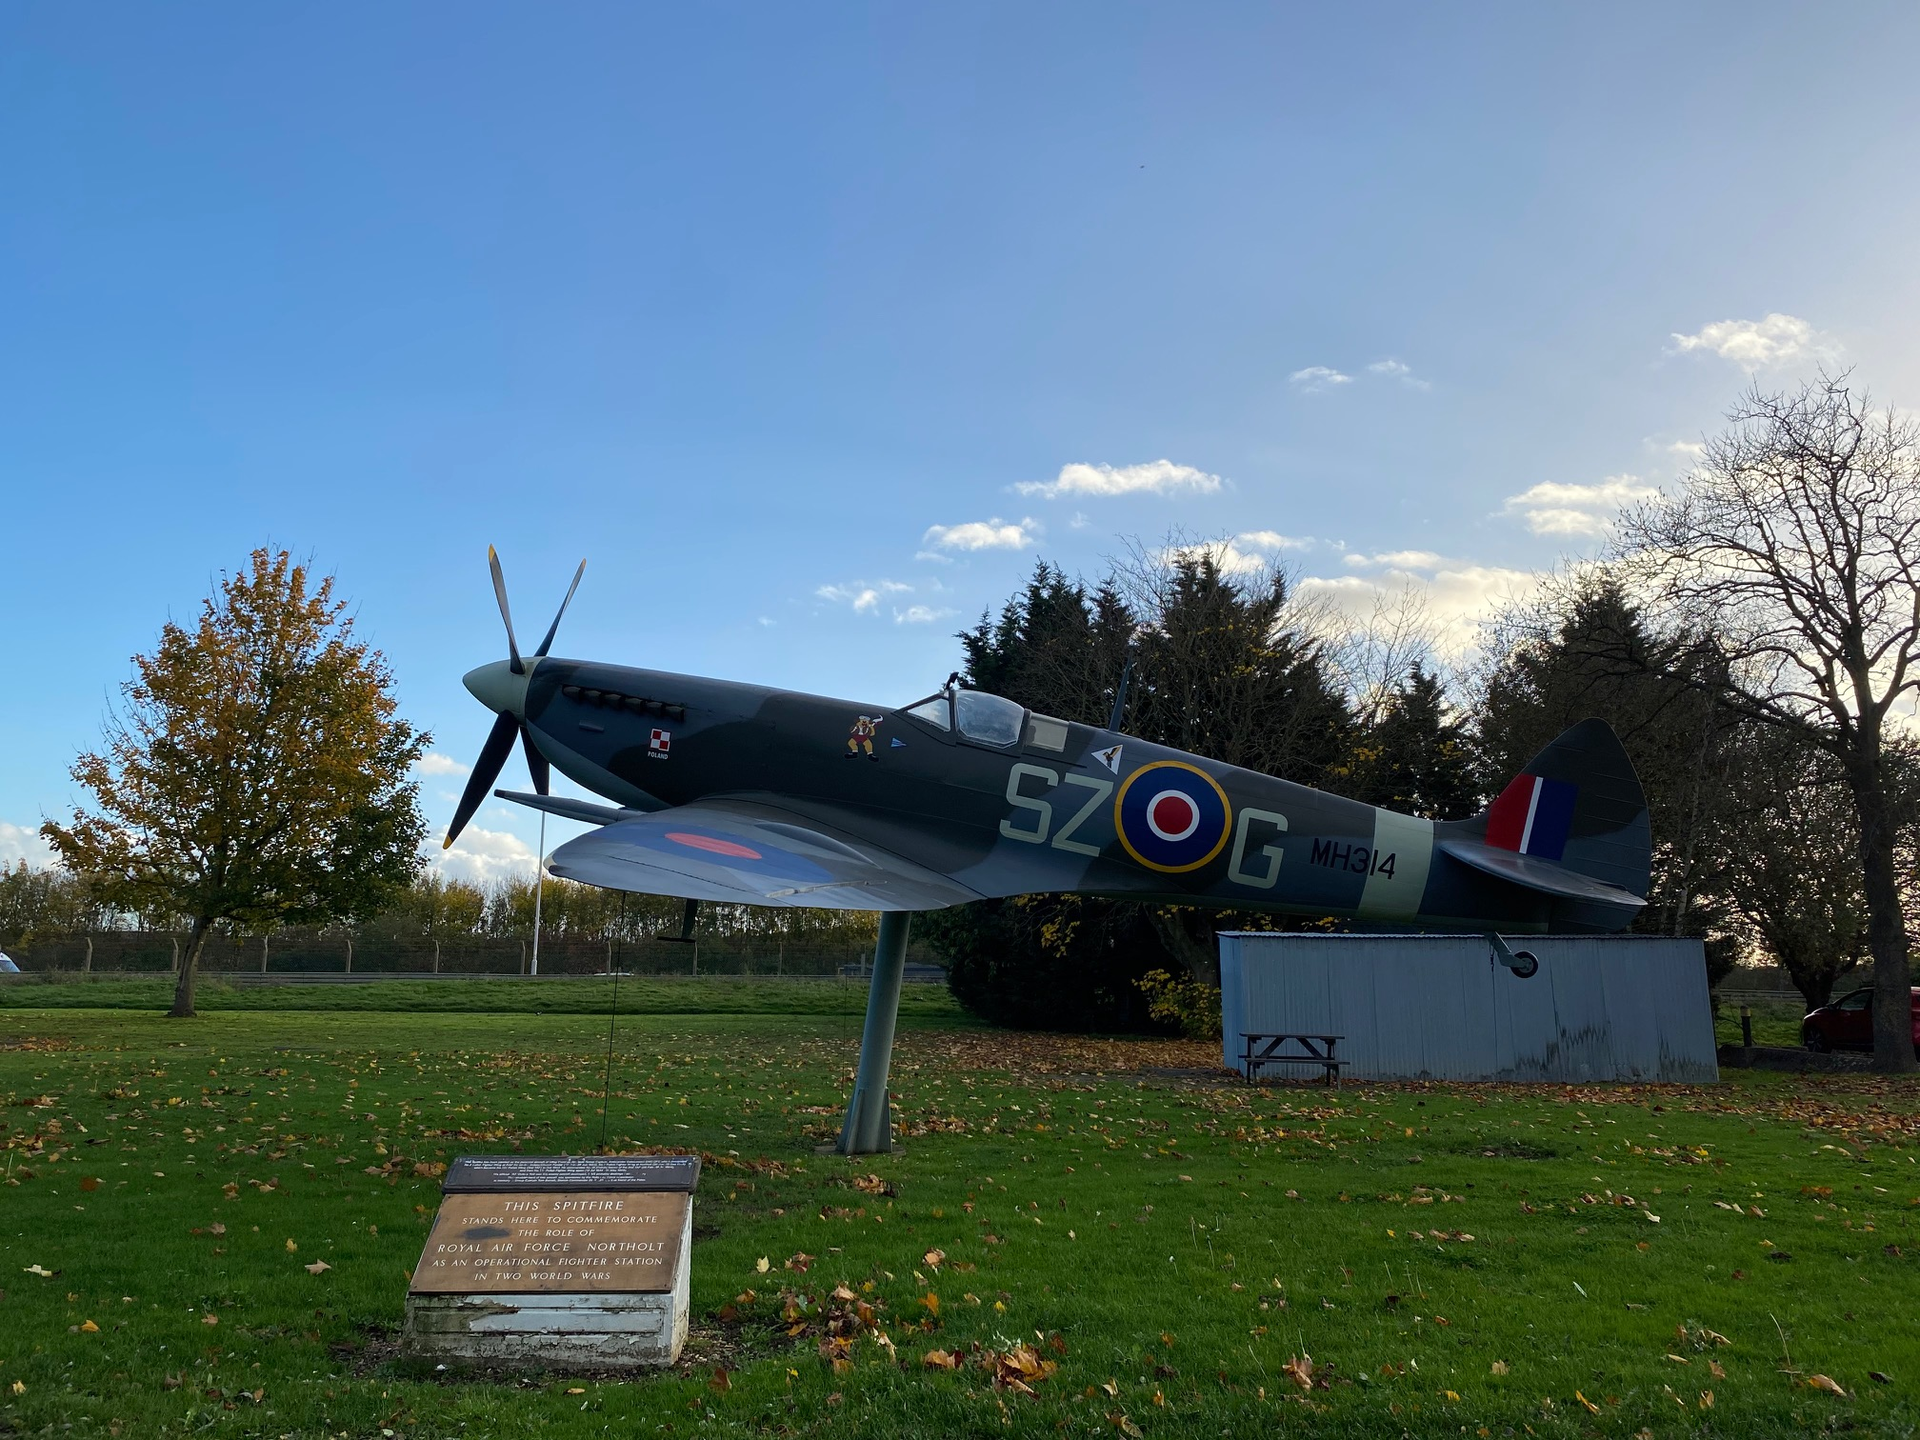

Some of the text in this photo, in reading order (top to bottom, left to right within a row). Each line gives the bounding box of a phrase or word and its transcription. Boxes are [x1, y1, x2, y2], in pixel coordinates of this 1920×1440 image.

[648, 751, 668, 760] POLAND
[999, 762, 1289, 890] SZ G
[1310, 837, 1397, 880] MH314
[504, 1200, 625, 1211] THIS SPITFIRE
[462, 1216, 658, 1225] STANDS HERE TO COMMEMORATE
[518, 1229, 540, 1237] THE
[546, 1229, 574, 1237] ROLE
[438, 1242, 665, 1253] ROYAL AIR FORCE NORTHOLT
[432, 1257, 663, 1267] AS AN OPERATIONAL FIGHTER STATION
[474, 1272, 611, 1281] IN TWO WORLD WARS
